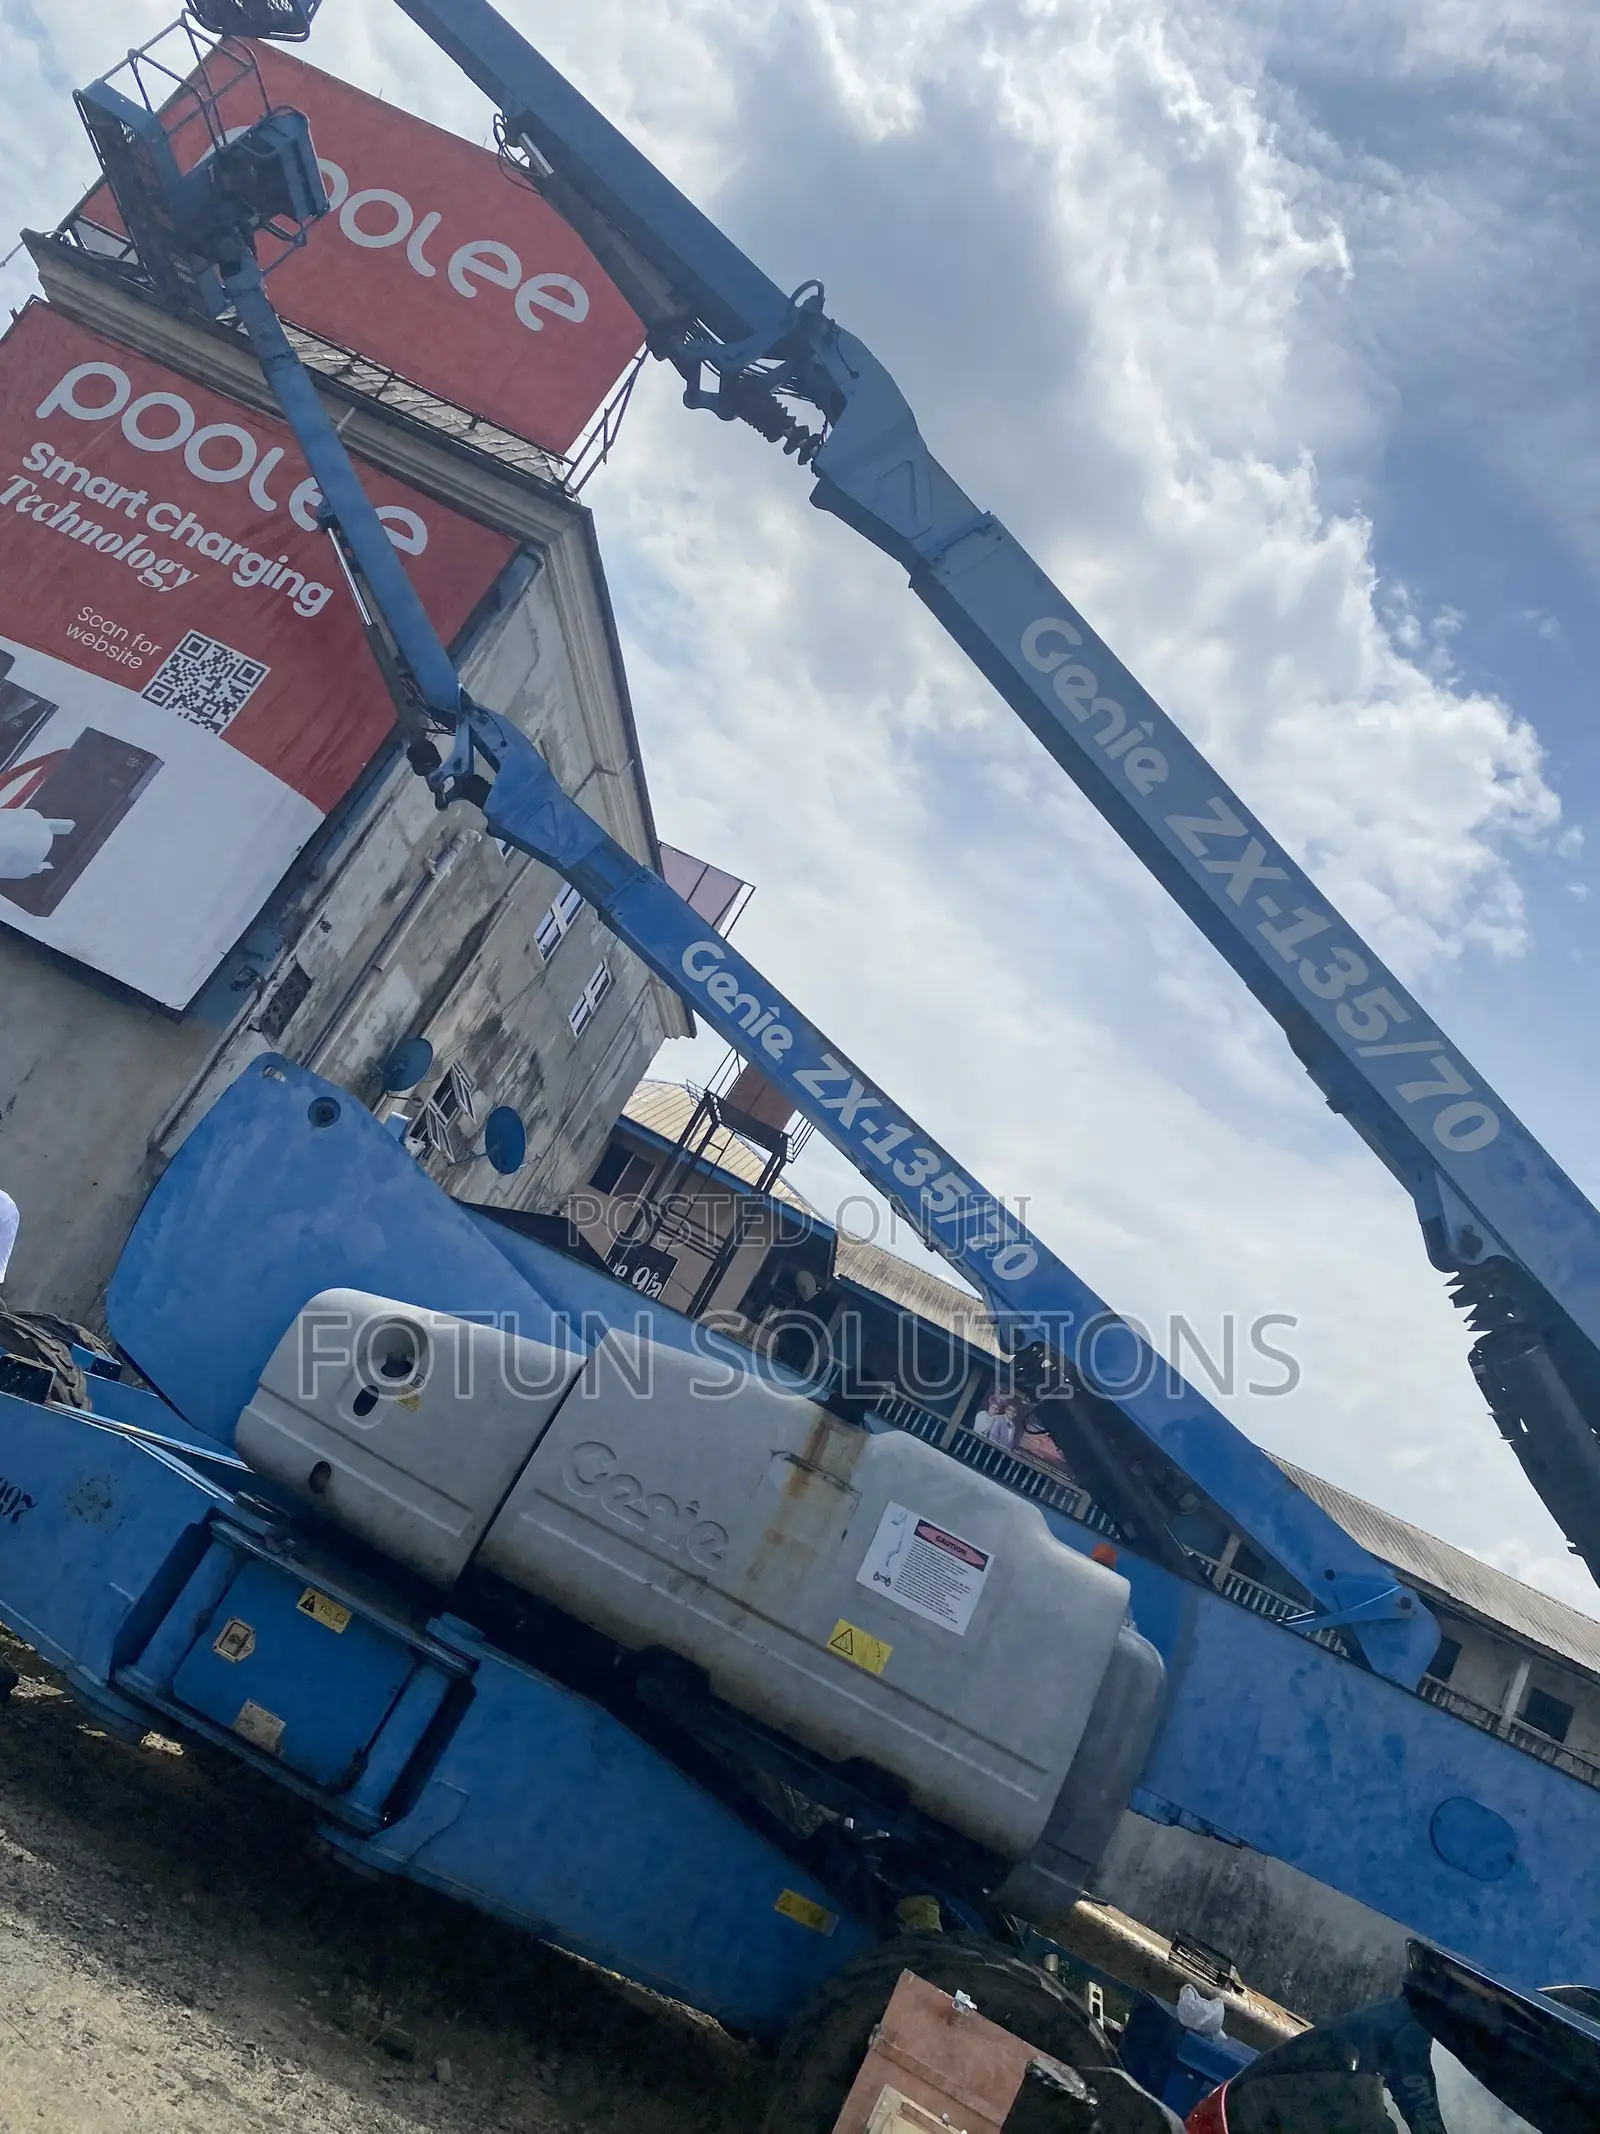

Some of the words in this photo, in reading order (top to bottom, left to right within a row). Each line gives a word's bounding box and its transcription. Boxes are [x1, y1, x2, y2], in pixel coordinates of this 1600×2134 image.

[0, 474, 200, 592] Technology
[22, 442, 149, 519] Smart
[146, 502, 334, 617] Charging
[66, 621, 143, 669] website
[77, 606, 128, 643] Scan
[135, 633, 162, 656] for
[1020, 617, 1169, 797] Genie
[1164, 796, 1500, 1153] ZX-135/70
[681, 940, 793, 1061] Genie
[791, 1052, 1039, 1281] ZX-135/70
[562, 1440, 730, 1571] Genie
[935, 1534, 968, 1557] CAUTION
